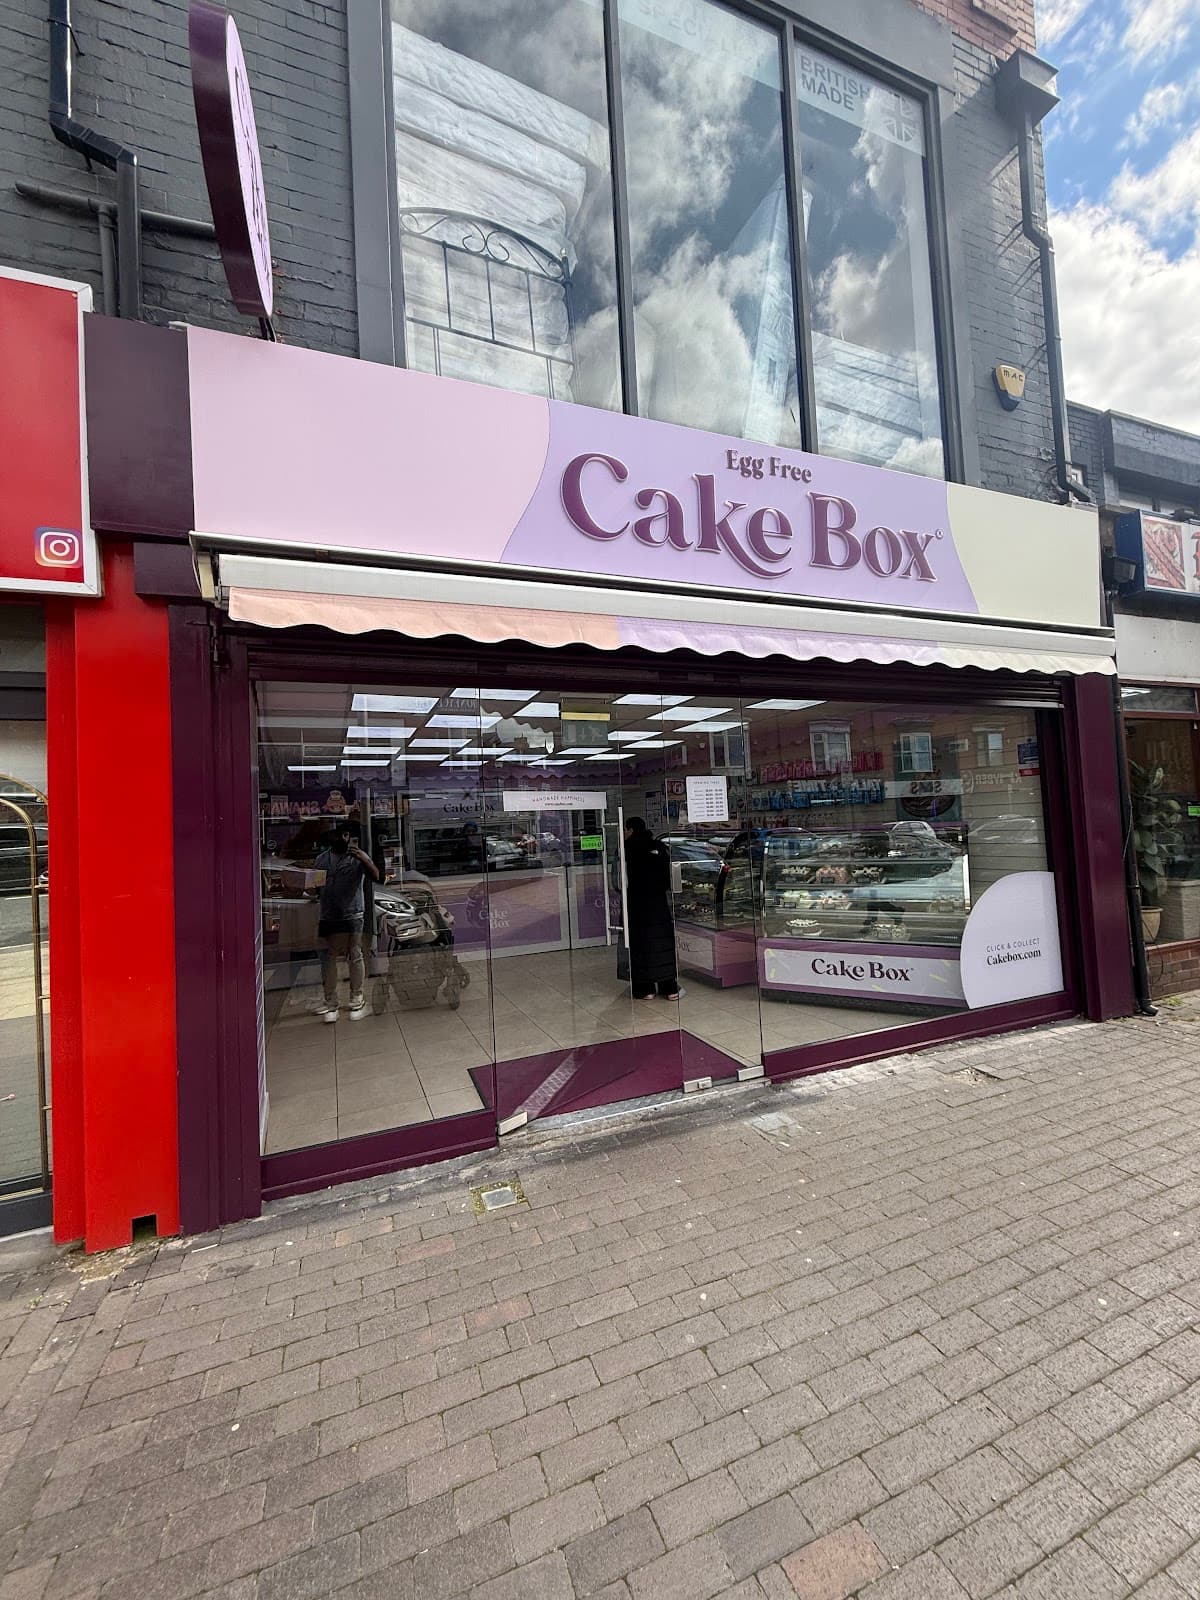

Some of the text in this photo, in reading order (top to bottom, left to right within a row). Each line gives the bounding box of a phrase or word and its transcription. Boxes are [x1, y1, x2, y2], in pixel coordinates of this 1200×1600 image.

[800, 55, 871, 99] BRITISH
[801, 77, 855, 111] MADE
[726, 449, 812, 484] Egg Free
[560, 452, 794, 578] Cake
[443, 802, 473, 814] Cake
[490, 918, 510, 929] Box
[986, 944, 1005, 953] CLICK
[1013, 937, 1040, 948] COLLECT
[986, 949, 1041, 966] Cakebox.com
[811, 958, 911, 982] Cake Box
